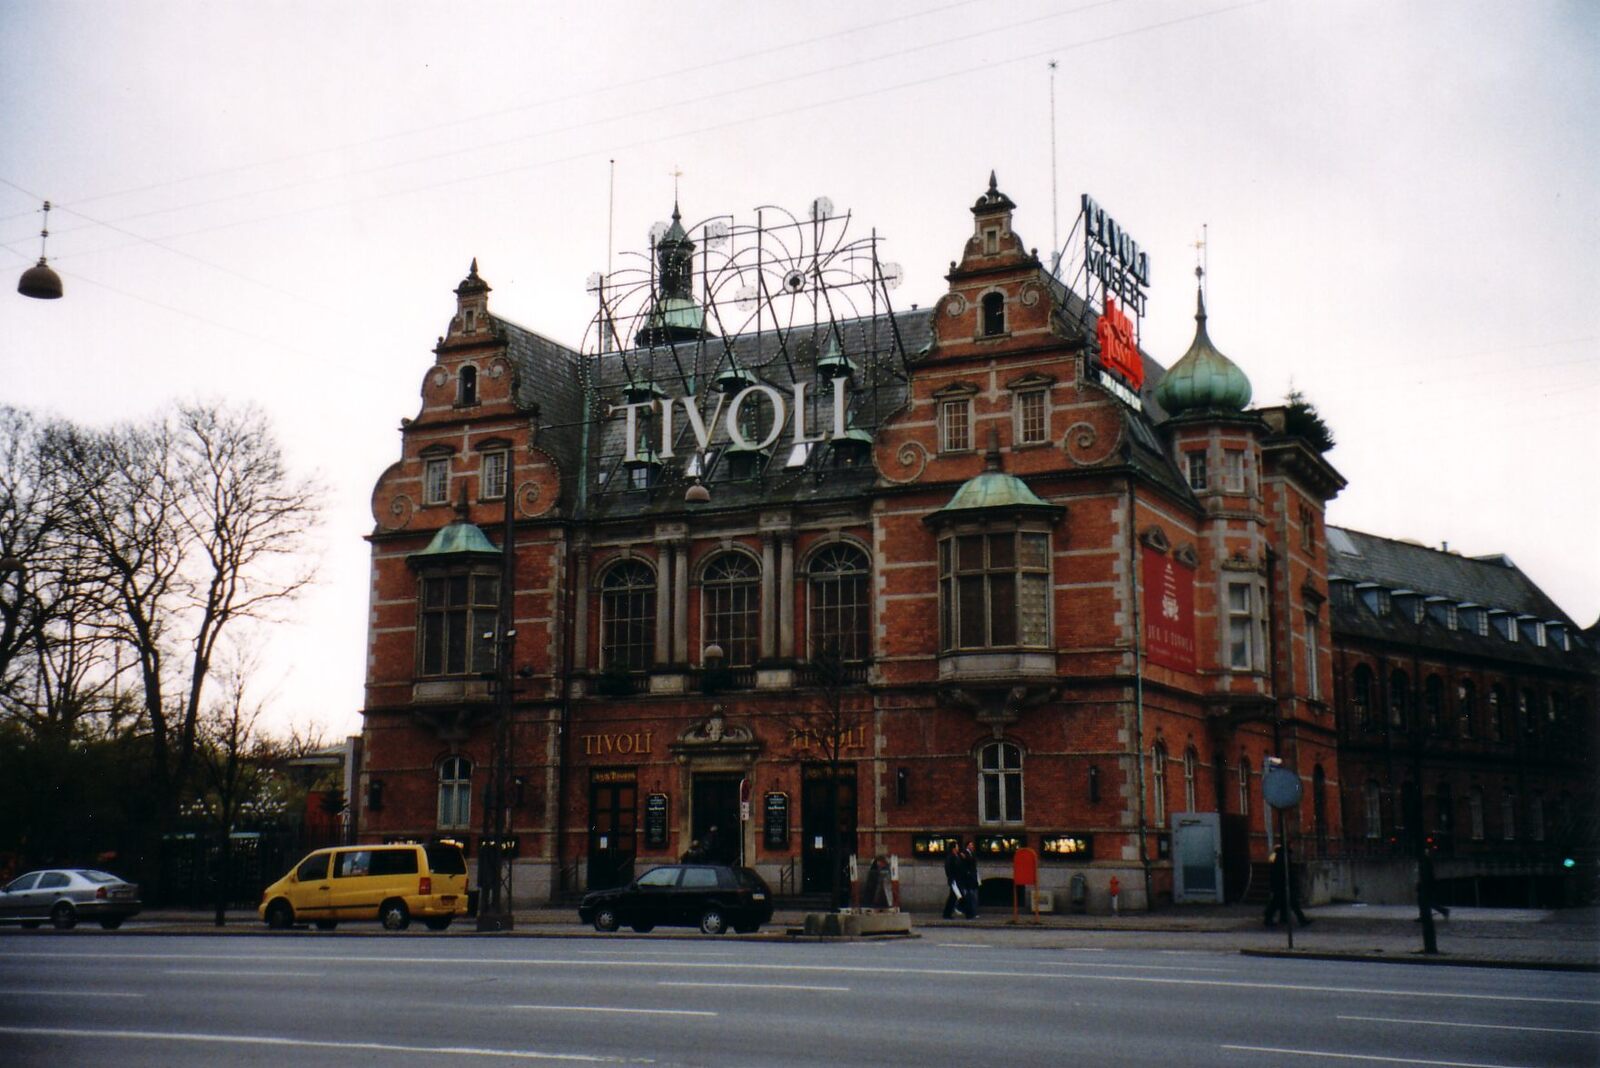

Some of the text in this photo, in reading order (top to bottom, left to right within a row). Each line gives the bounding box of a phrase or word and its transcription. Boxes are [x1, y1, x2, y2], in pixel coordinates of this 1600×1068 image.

[1081, 194, 1150, 287] TIVOLI
[608, 377, 849, 462] TIVOLI
[581, 731, 652, 755] TIVOLI
